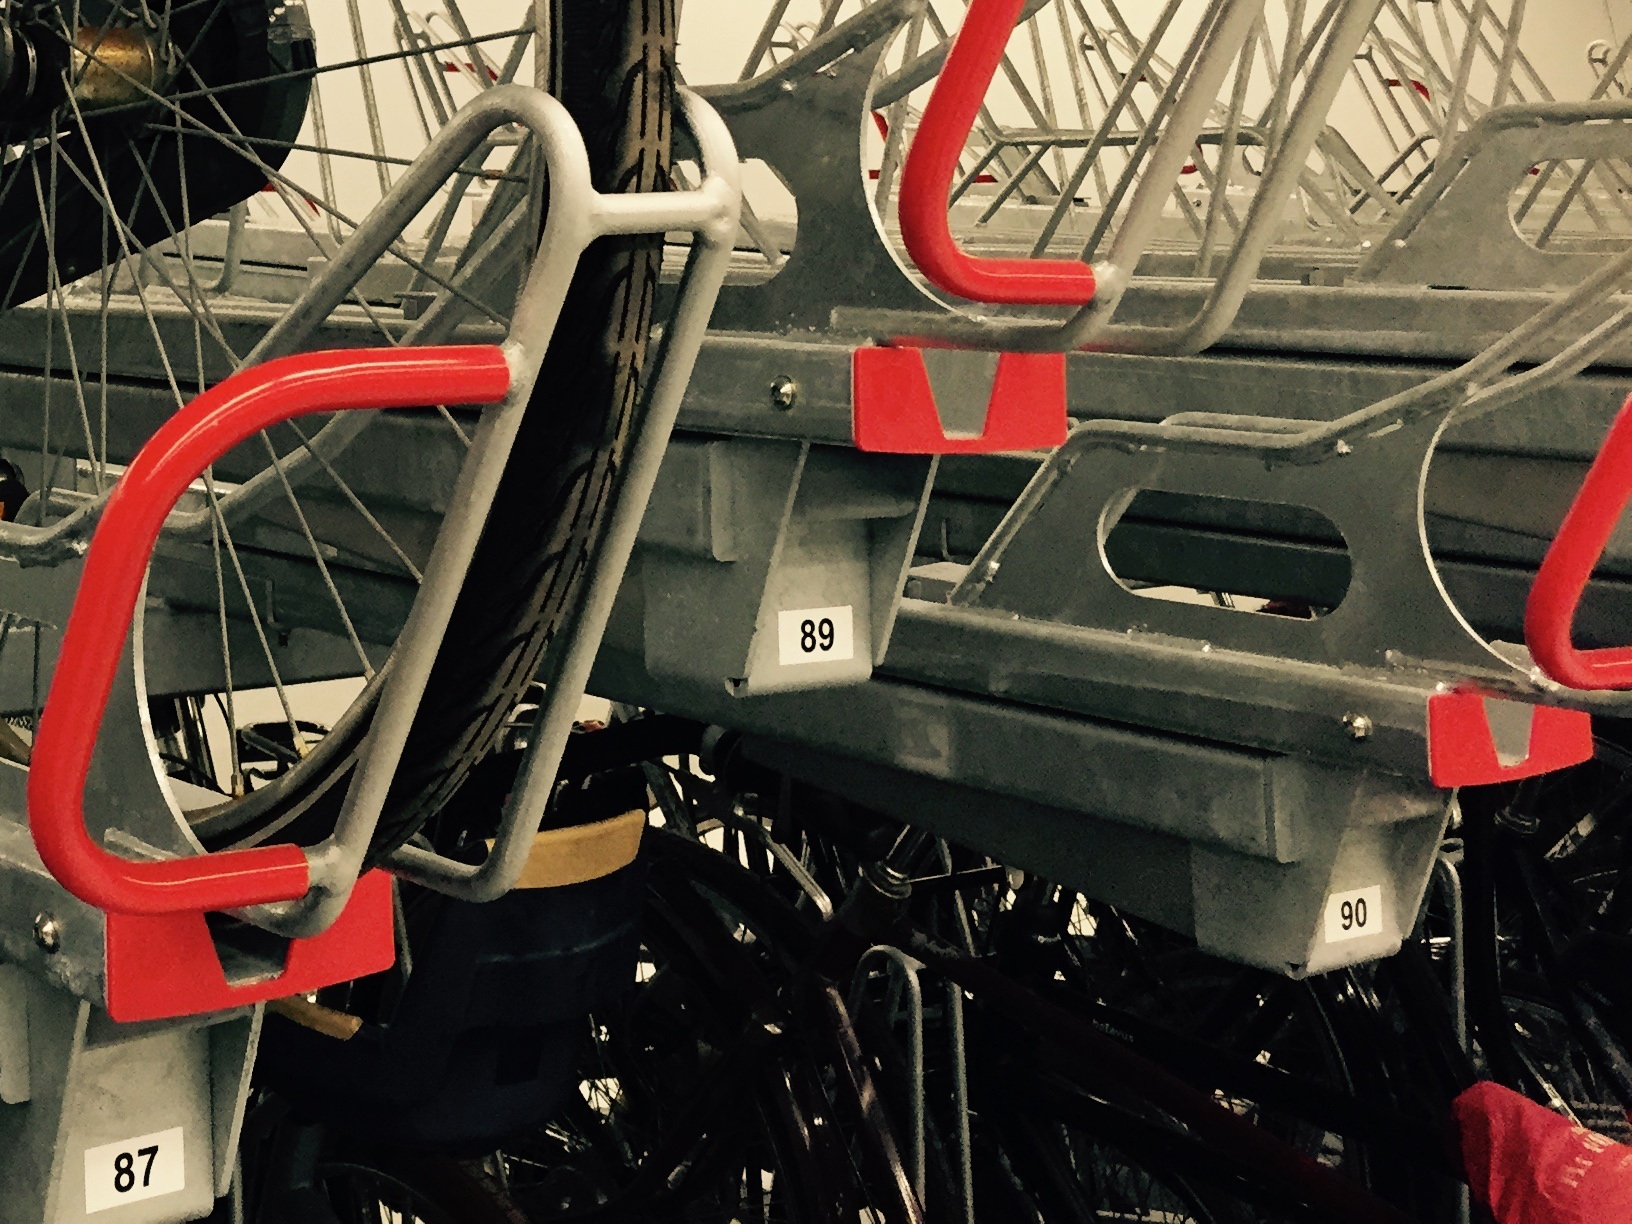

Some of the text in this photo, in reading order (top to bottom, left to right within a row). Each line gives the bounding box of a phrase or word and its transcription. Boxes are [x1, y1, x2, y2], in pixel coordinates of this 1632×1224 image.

[800, 617, 835, 653] 89
[1340, 897, 1367, 931] 90
[114, 1145, 159, 1193] 87
